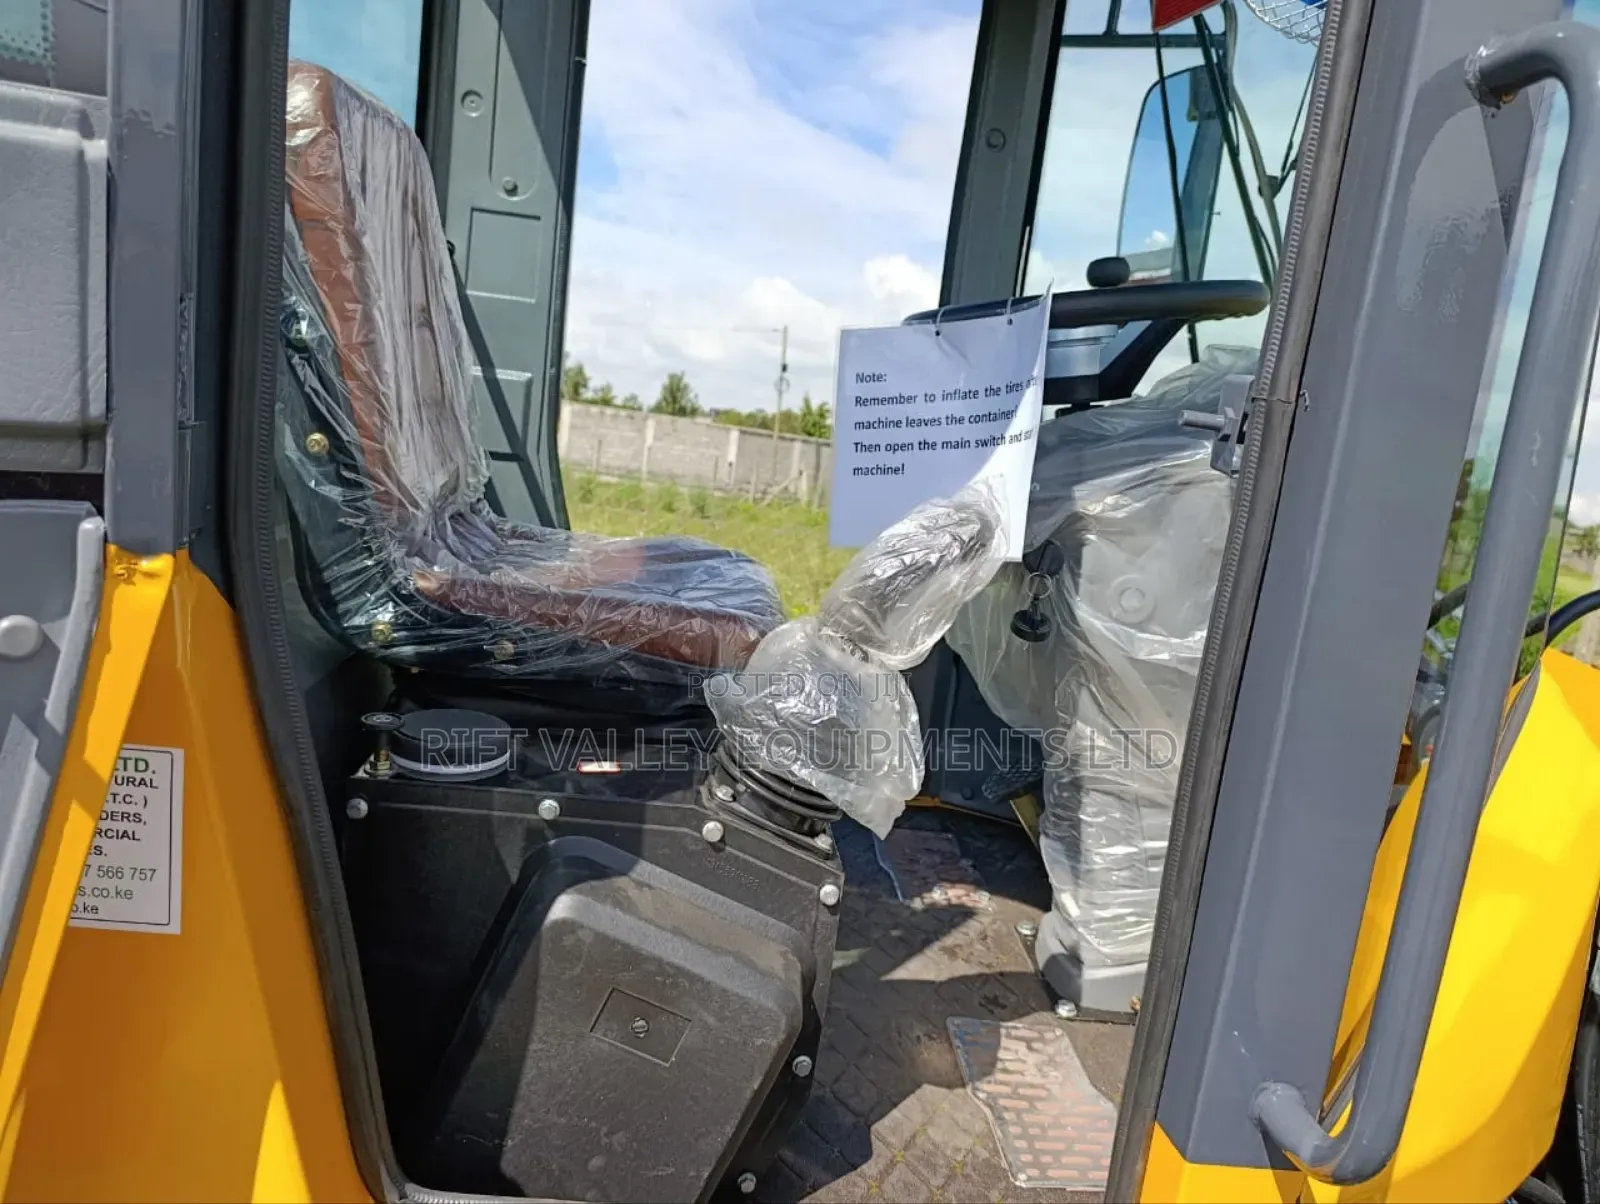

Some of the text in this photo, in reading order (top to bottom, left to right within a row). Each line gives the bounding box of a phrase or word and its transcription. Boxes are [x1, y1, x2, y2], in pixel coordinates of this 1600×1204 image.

[855, 372, 887, 384] Note:
[854, 394, 918, 408] Remember
[924, 392, 936, 403] to
[942, 388, 980, 402] inflate
[984, 385, 1002, 398] the
[1006, 381, 1024, 394] tires
[854, 416, 902, 430] machine
[905, 413, 942, 427] leaves
[945, 411, 965, 425] the
[853, 441, 881, 453] Then
[885, 441, 914, 455] open
[918, 439, 937, 451] the
[941, 436, 971, 450] main
[975, 433, 1006, 448] switch
[1008, 430, 1023, 444] and
[853, 463, 905, 476] machine!
[114, 775, 159, 789] URAL
[99, 810, 147, 826] DERS,
[94, 827, 141, 842] RCIAL
[97, 865, 125, 880] 566
[129, 867, 157, 882] 757
[78, 884, 134, 900] s.co.ke
[71, 902, 99, 915] o.ke
